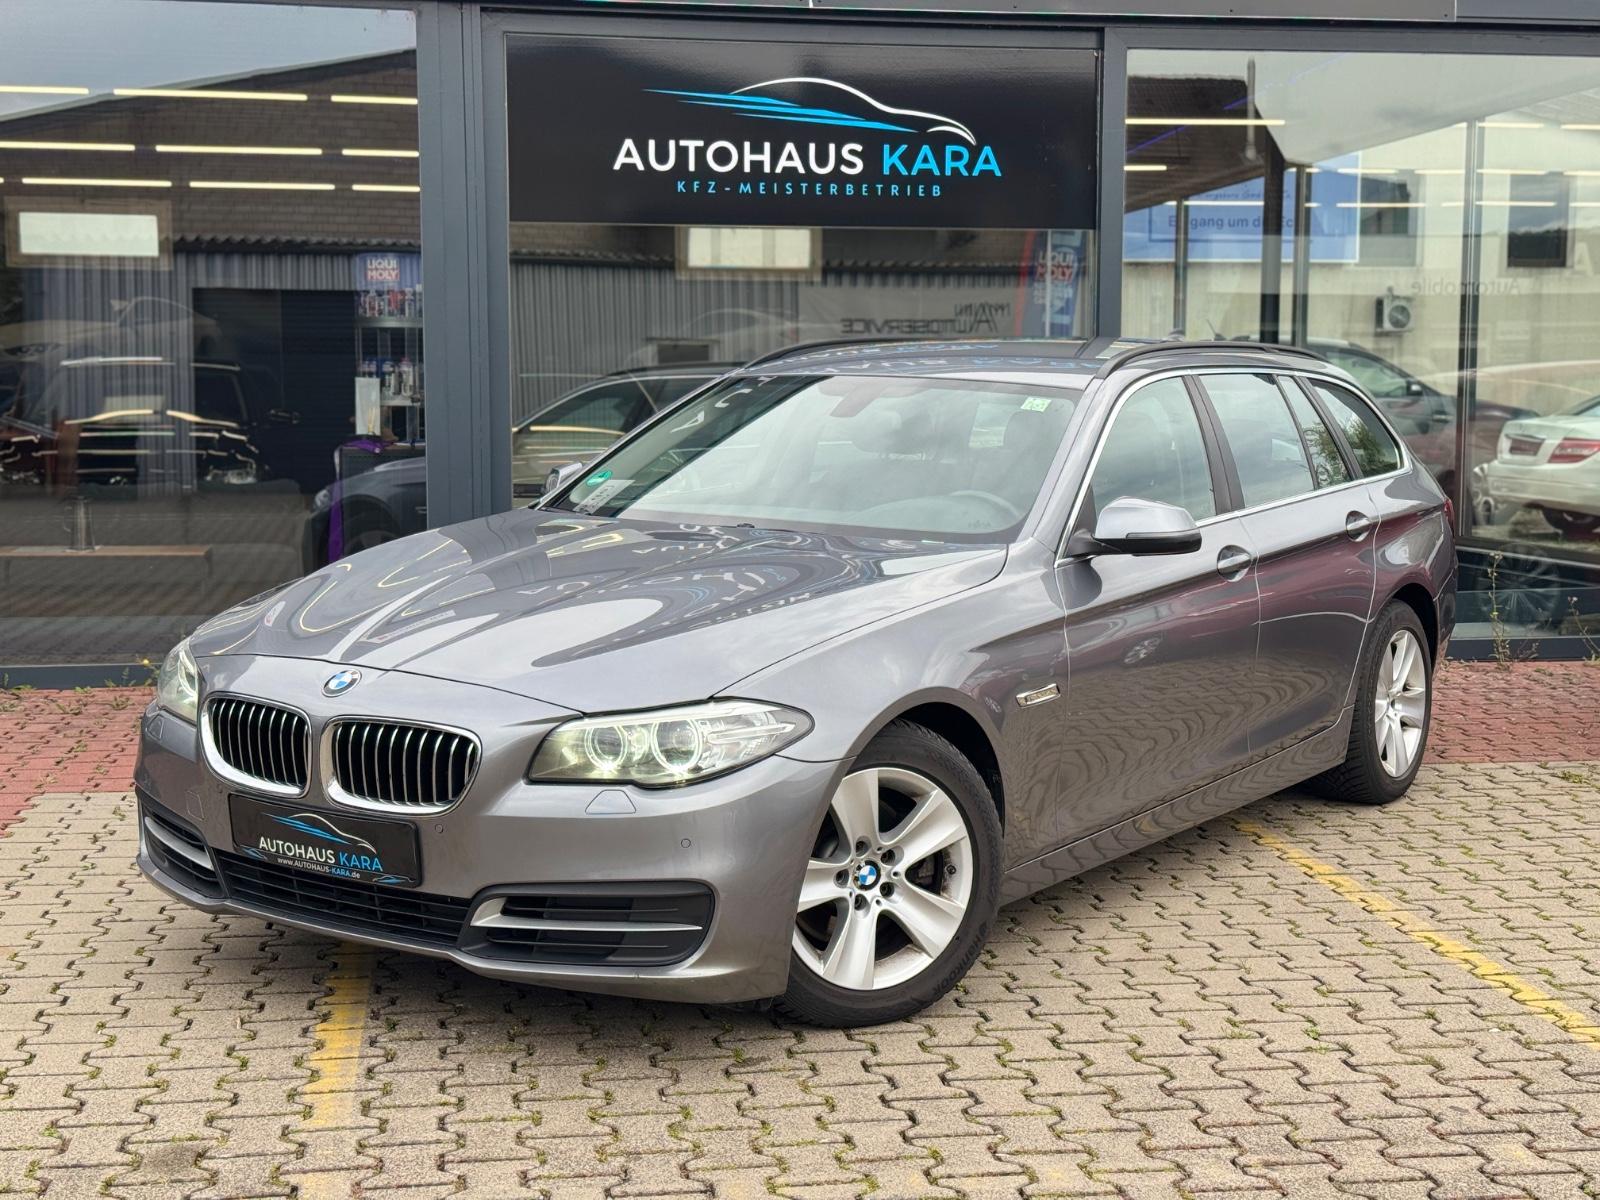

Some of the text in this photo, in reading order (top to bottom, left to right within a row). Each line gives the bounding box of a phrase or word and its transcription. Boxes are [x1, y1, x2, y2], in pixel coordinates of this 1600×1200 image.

[612, 138, 1002, 177] AUTOHAUS KARA
[677, 181, 942, 197] KFZ-MEISTERBETRIEB
[1228, 217, 1249, 228] um
[367, 257, 398, 269] LIQUI
[1038, 250, 1075, 265] LQUI
[367, 269, 400, 280] MOLY
[259, 836, 383, 872] AUTOHAUS KARA
[277, 857, 361, 879] www.AUTOHAUS-KARA.de
